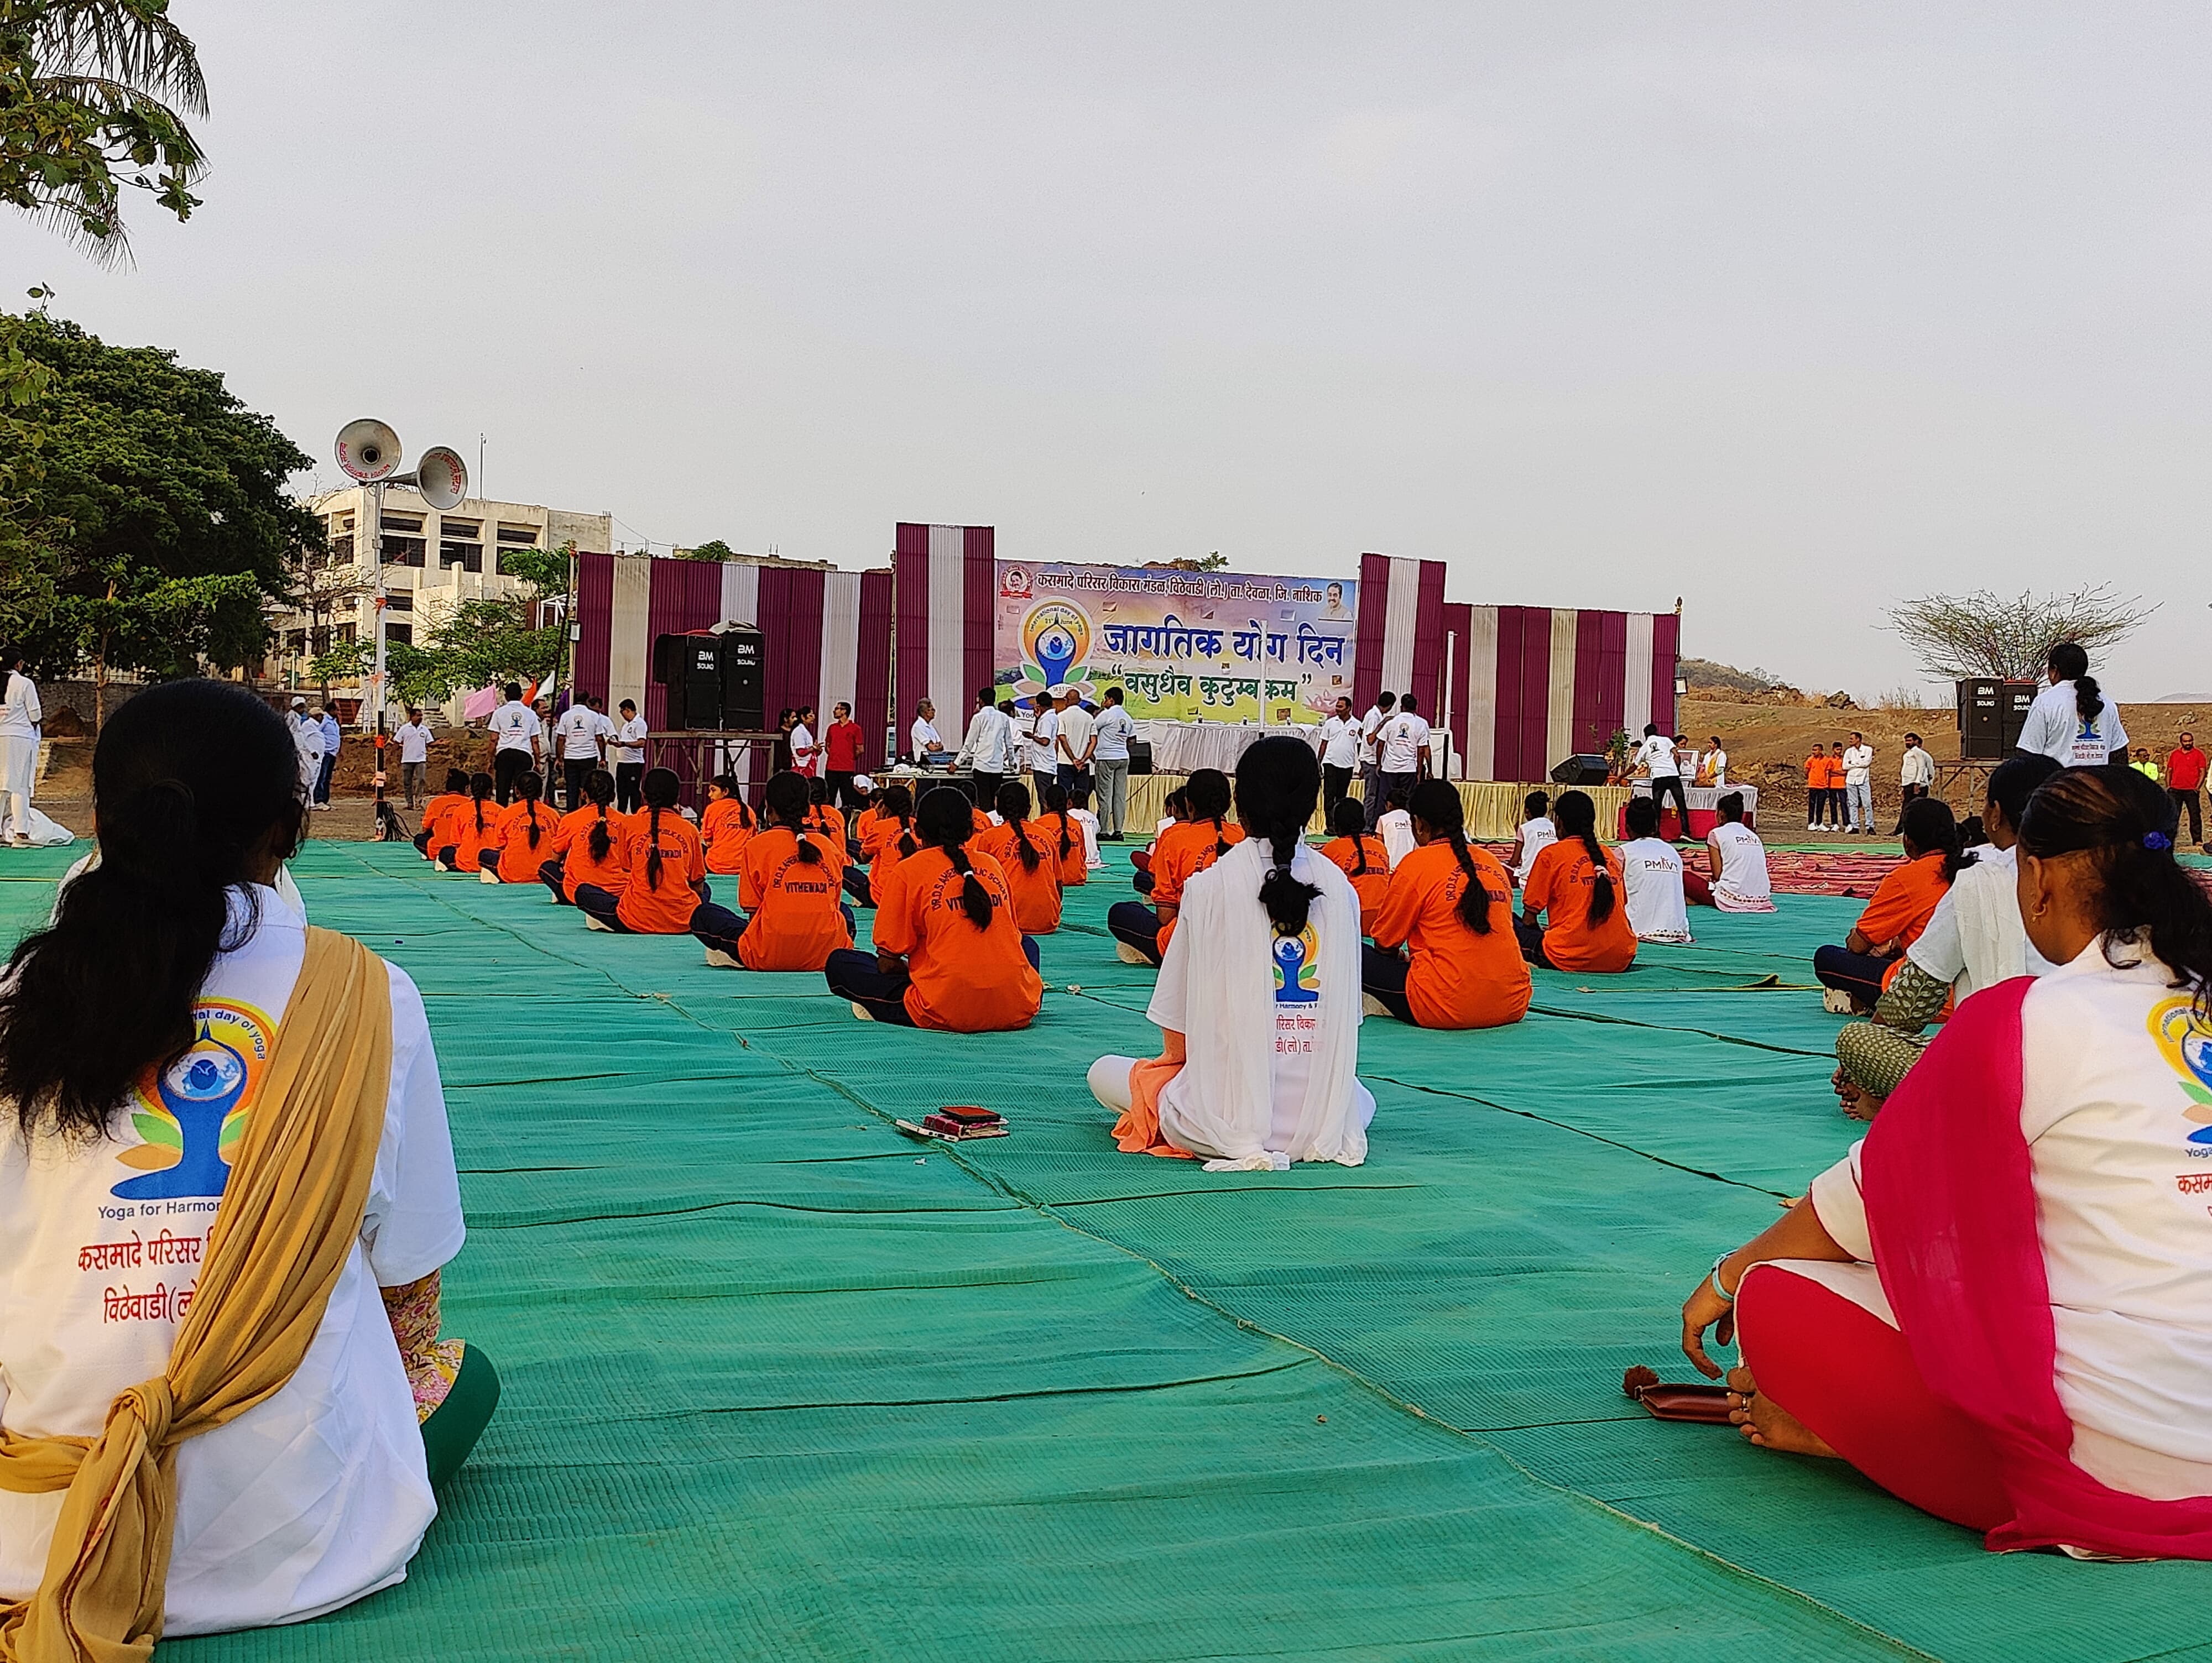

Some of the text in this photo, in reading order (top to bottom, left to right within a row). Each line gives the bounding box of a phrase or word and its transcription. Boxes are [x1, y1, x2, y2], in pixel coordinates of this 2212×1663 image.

[1037, 570, 1074, 589] कसमादे
[1077, 571, 1107, 589] परिसर
[1109, 572, 1141, 592] विकास
[1170, 576, 1204, 595] विठेवाडी
[1292, 584, 1322, 603] नाशिक
[698, 651, 713, 661] BM
[738, 645, 754, 654] BM
[1104, 614, 1344, 669] जागतिक योग दिन
[215, 1010, 240, 1024] day
[241, 1021, 255, 1031] of
[249, 1031, 265, 1059] yoga
[98, 1201, 221, 1221] Yoga for Harmo
[78, 1230, 143, 1272] कसमादे
[148, 1228, 202, 1265] परिसर
